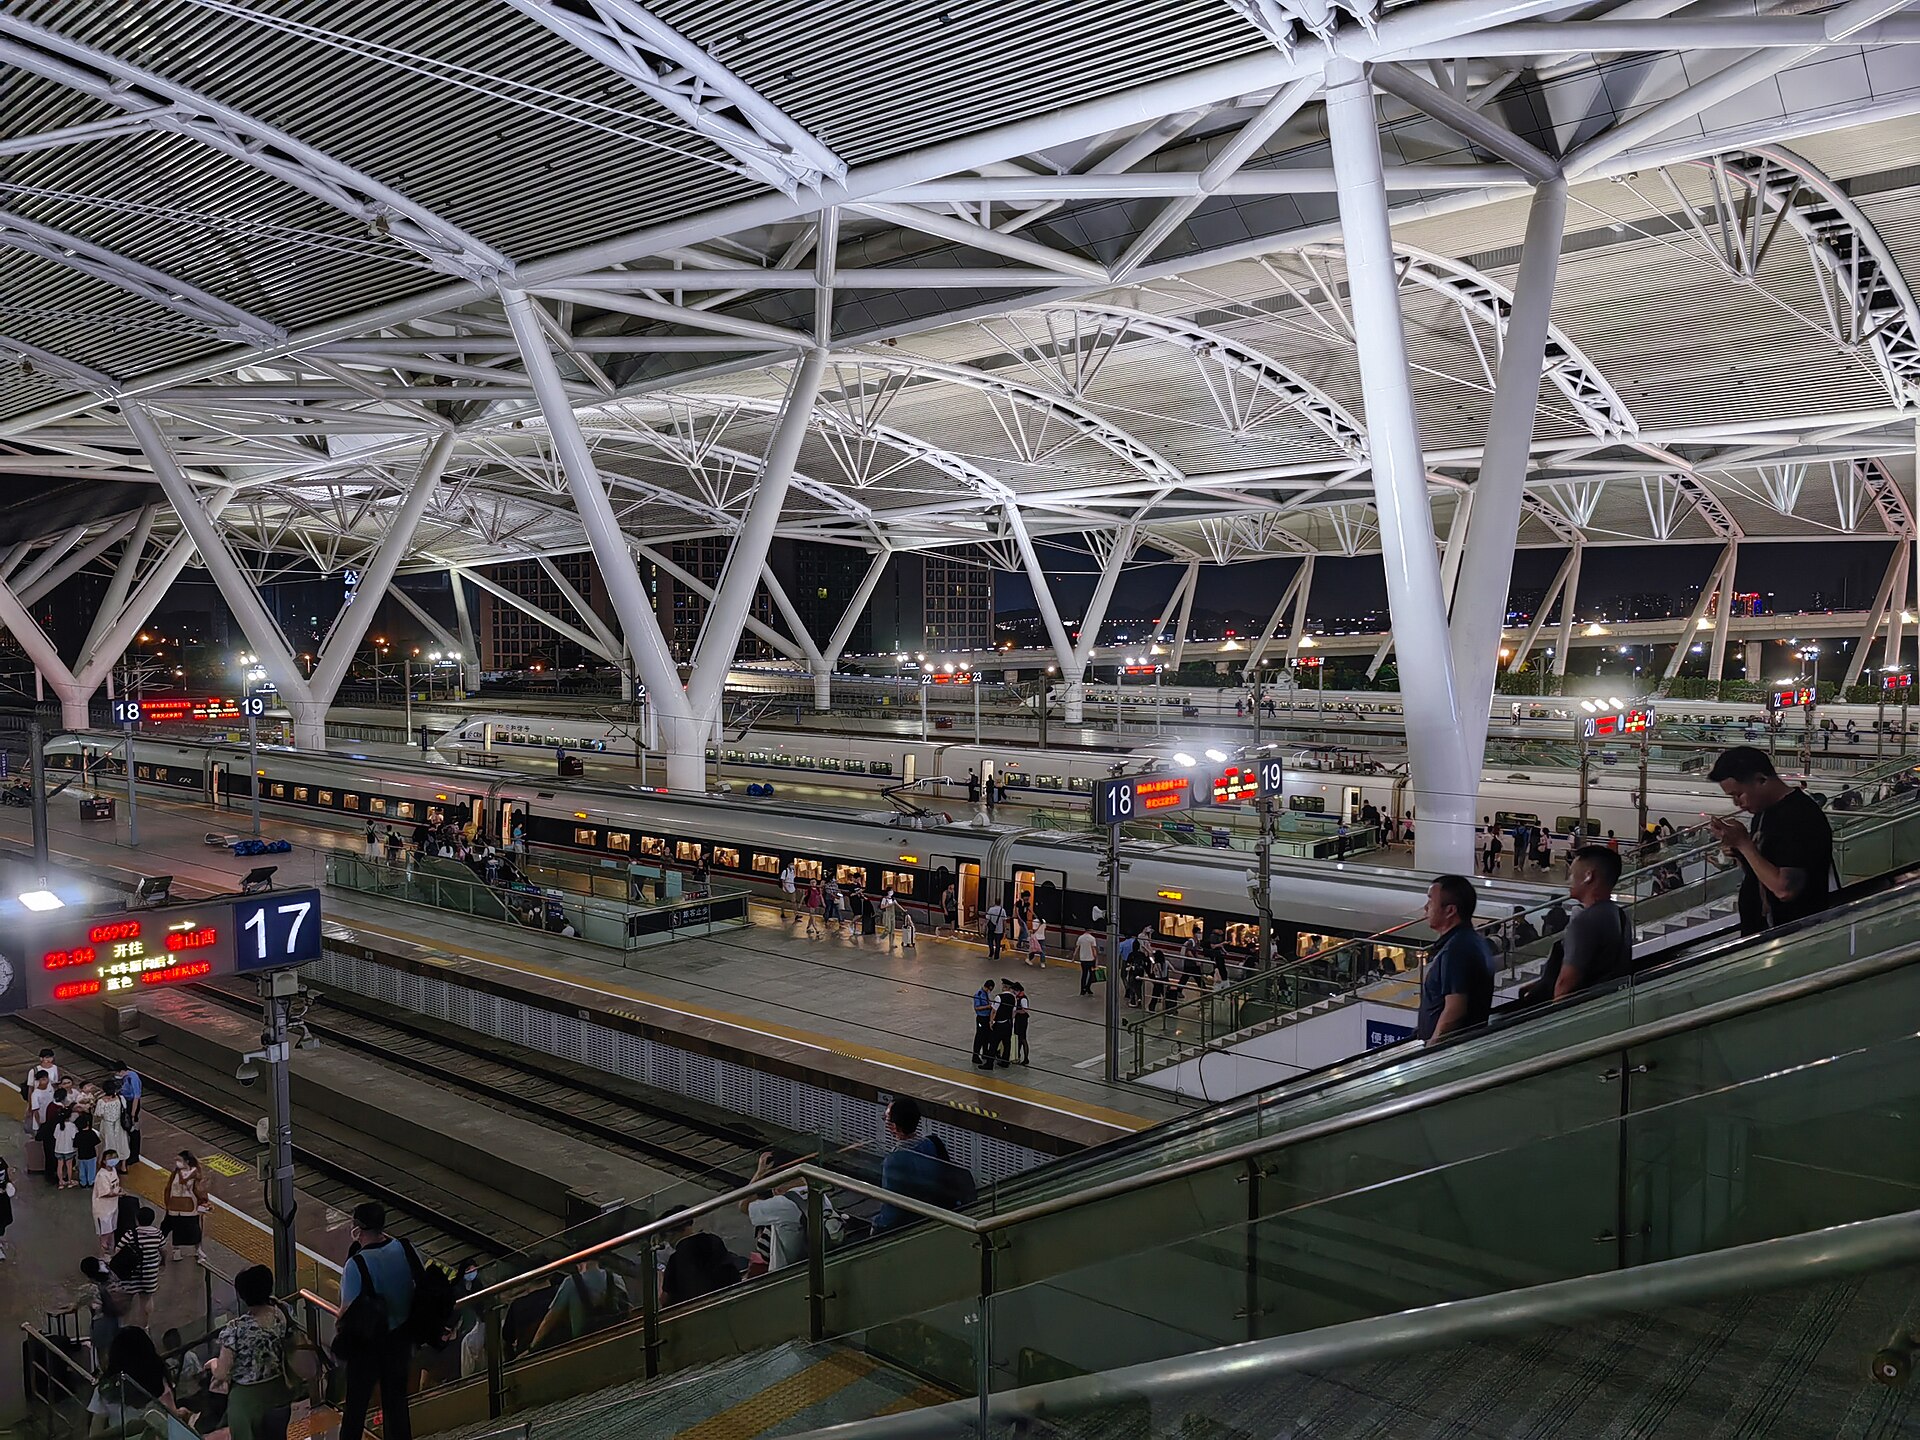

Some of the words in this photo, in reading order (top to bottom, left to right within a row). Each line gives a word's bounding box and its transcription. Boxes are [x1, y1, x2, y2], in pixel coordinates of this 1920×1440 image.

[921, 674, 932, 684] 22
[972, 671, 982, 682] 23
[241, 698, 264, 716] 19
[1773, 692, 1781, 708] 22
[115, 703, 140, 721] 18
[1645, 709, 1655, 728] 21
[1584, 717, 1596, 738] 20
[1261, 763, 1281, 791] 19
[1108, 784, 1132, 816] 18
[90, 921, 141, 943] G6992
[244, 901, 312, 960] 17
[45, 947, 96, 969] 20:04
[113, 941, 144, 958] 开往
